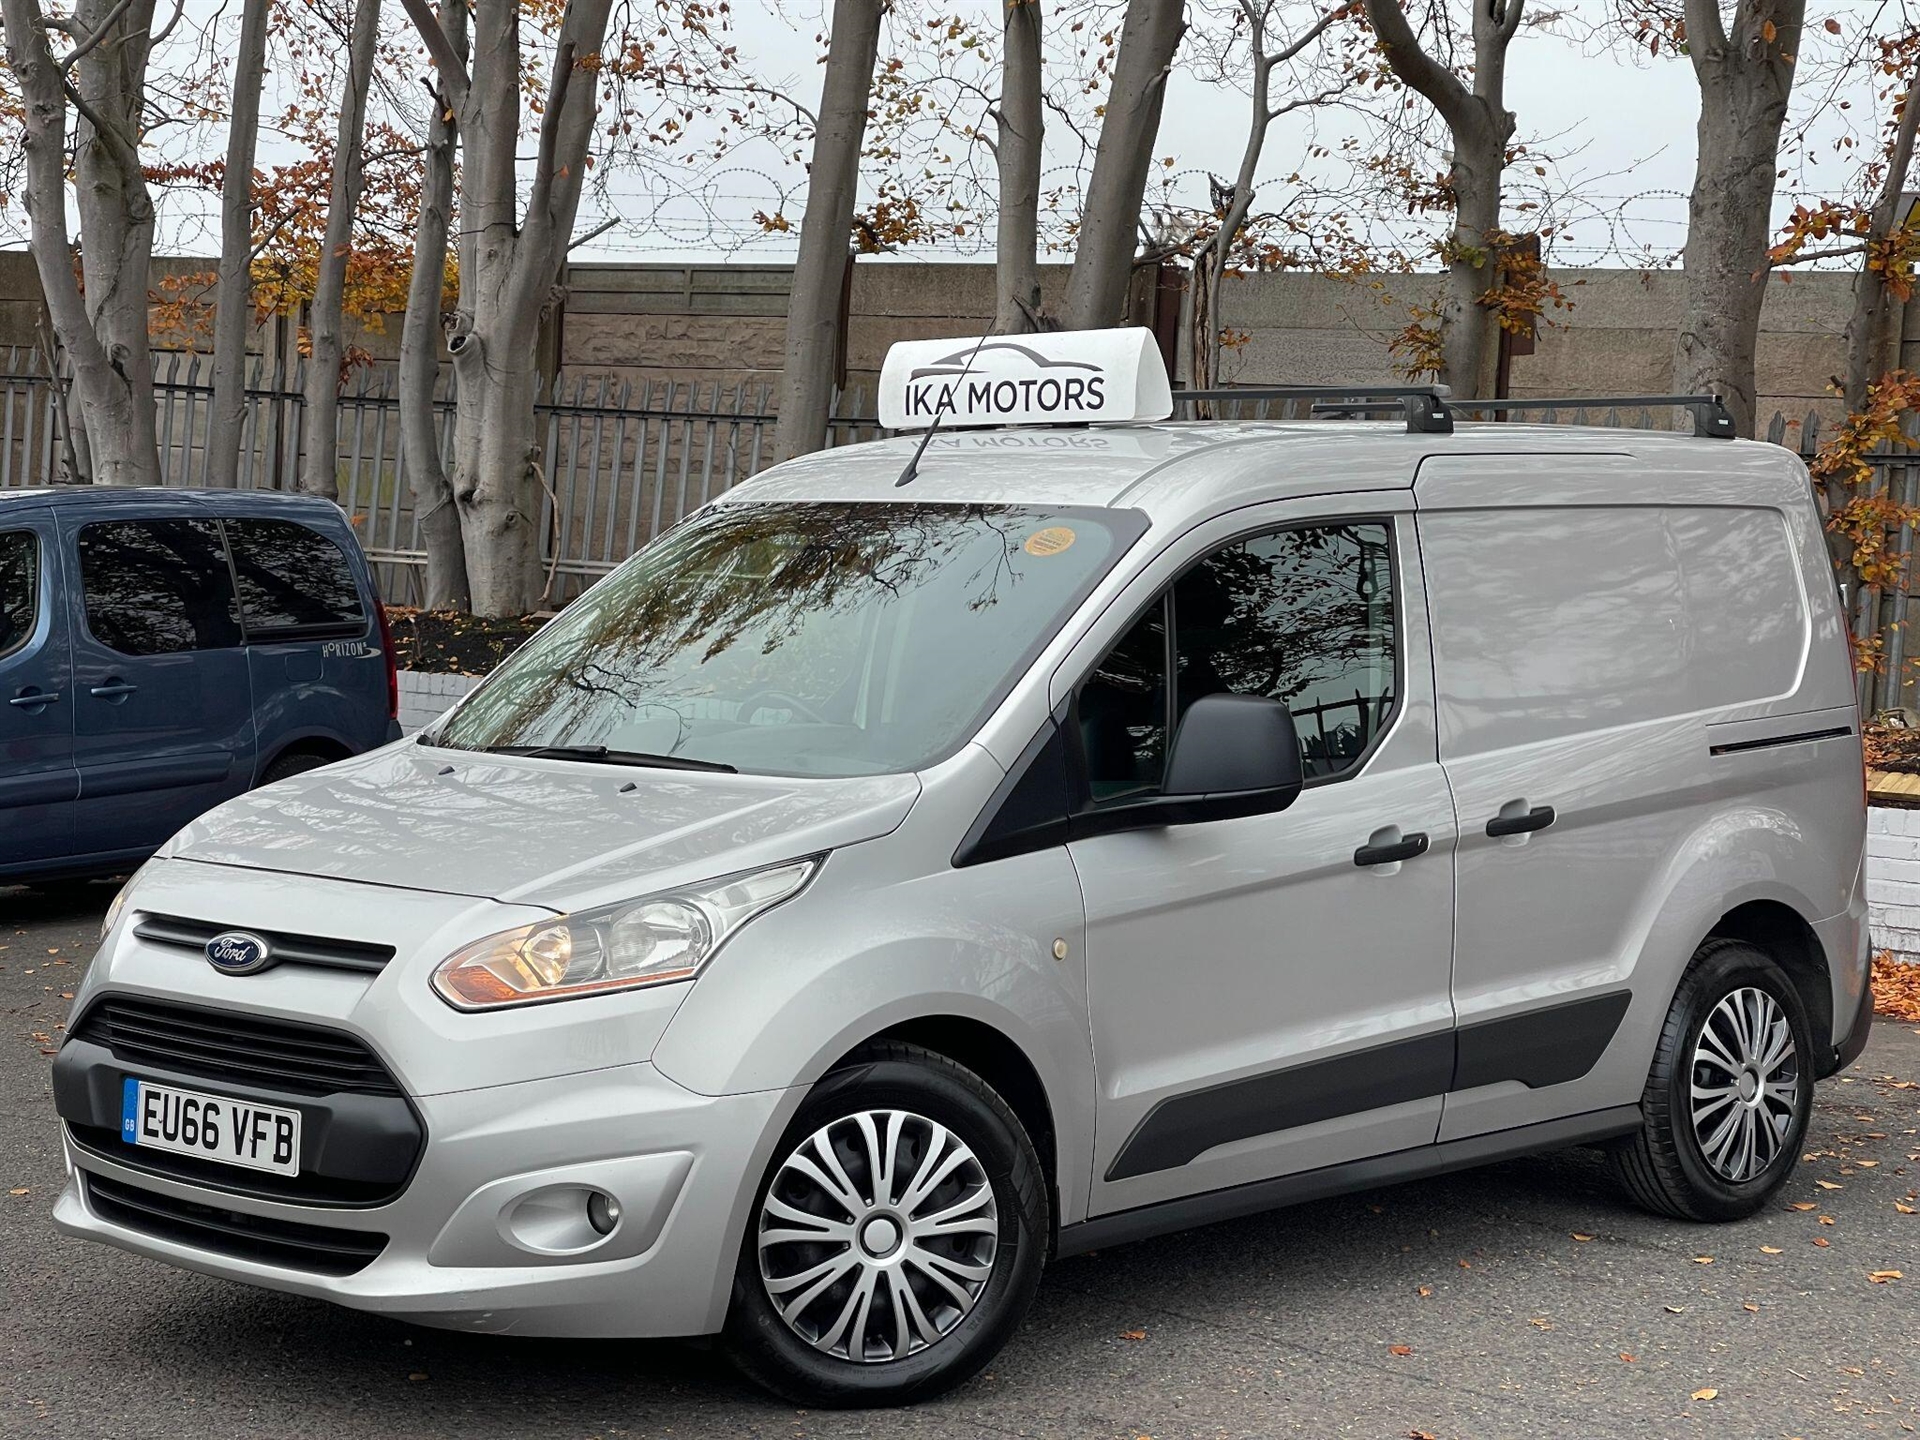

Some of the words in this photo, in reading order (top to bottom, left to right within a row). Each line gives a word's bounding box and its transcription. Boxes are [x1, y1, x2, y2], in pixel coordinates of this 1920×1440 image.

[905, 382, 957, 416] IKA
[967, 376, 1105, 414] MOTORS
[214, 937, 251, 962] Ford
[124, 1117, 135, 1132] GB
[143, 1089, 221, 1150] EU66
[231, 1106, 294, 1165] VFB
